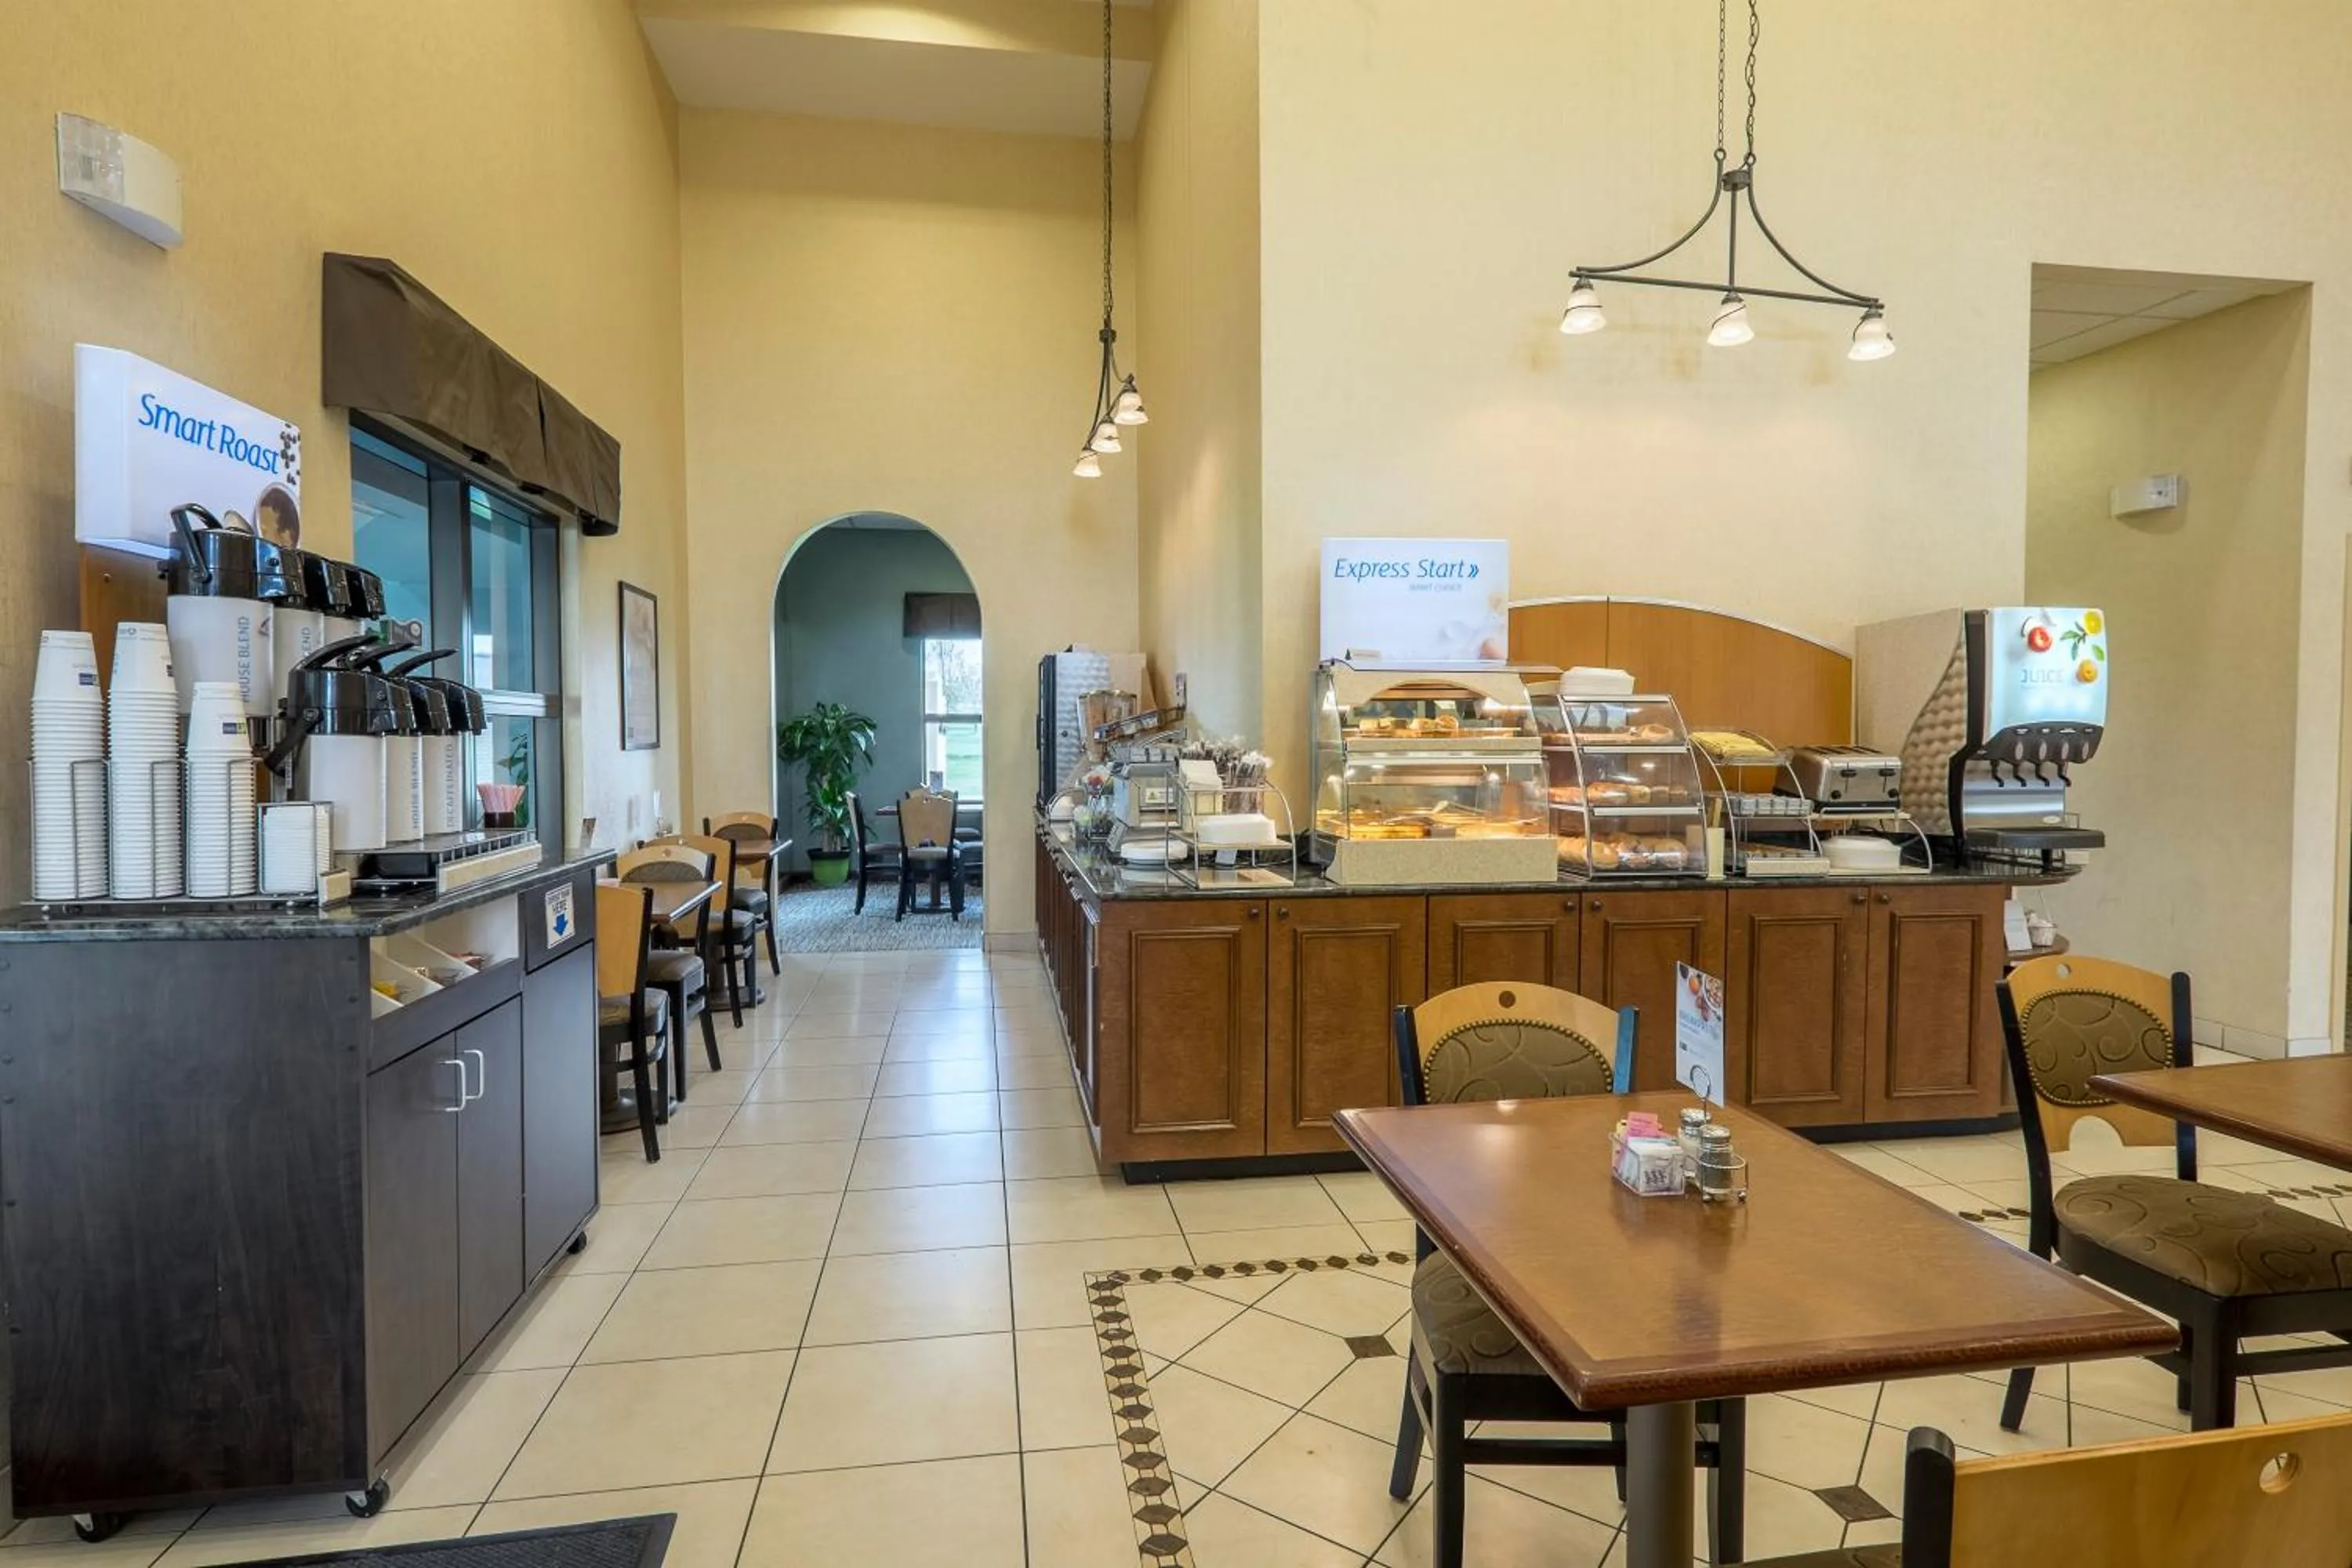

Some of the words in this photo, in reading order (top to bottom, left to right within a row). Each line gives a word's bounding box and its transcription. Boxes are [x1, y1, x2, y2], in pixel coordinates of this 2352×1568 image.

[138, 393, 216, 451] Smart
[219, 424, 279, 474] Roast
[1334, 557, 1410, 583] Express
[1417, 557, 1465, 579] Start
[238, 615, 250, 659] BLEND
